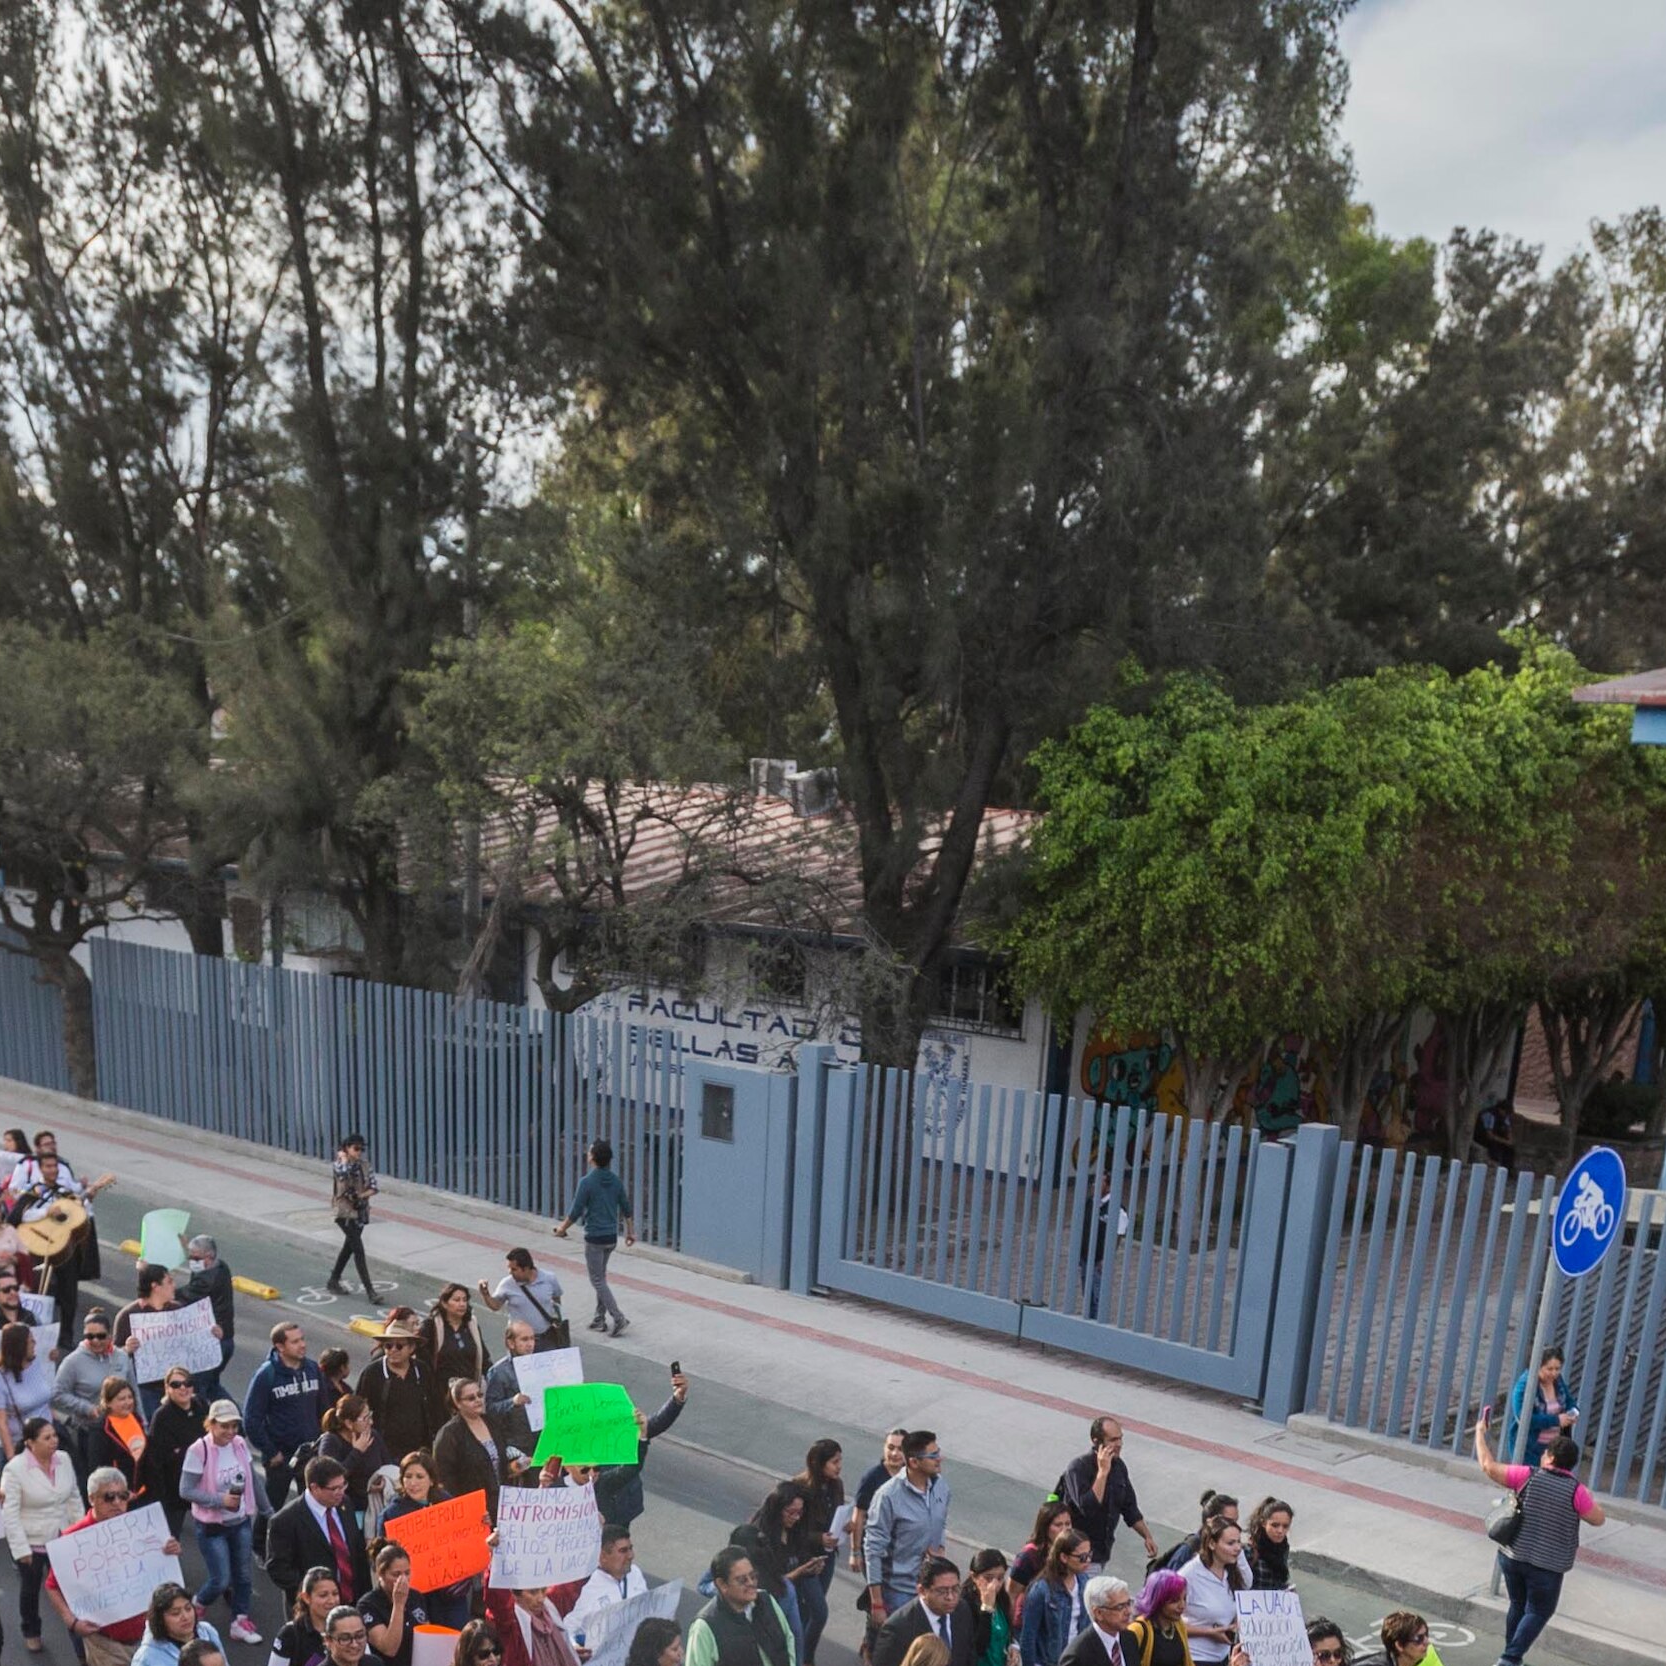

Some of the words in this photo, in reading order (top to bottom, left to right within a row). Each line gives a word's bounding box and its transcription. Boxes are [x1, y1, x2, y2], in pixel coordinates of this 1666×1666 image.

[629, 993, 818, 1040] FACULTAD
[501, 1485, 573, 1504] EXIGIMOS
[394, 1501, 465, 1539] GOBIERNO
[498, 1502, 596, 1522] INTROMISION
[74, 1507, 158, 1556] FUERA
[499, 1523, 527, 1539] DEL
[429, 1551, 443, 1568] de
[448, 1546, 458, 1560] la
[523, 1540, 549, 1555] LOS
[427, 1561, 464, 1588] UAQ
[501, 1559, 521, 1576] DE
[534, 1558, 553, 1576] LA
[1237, 1591, 1263, 1616] LA
[1264, 1590, 1293, 1616] UAQ
